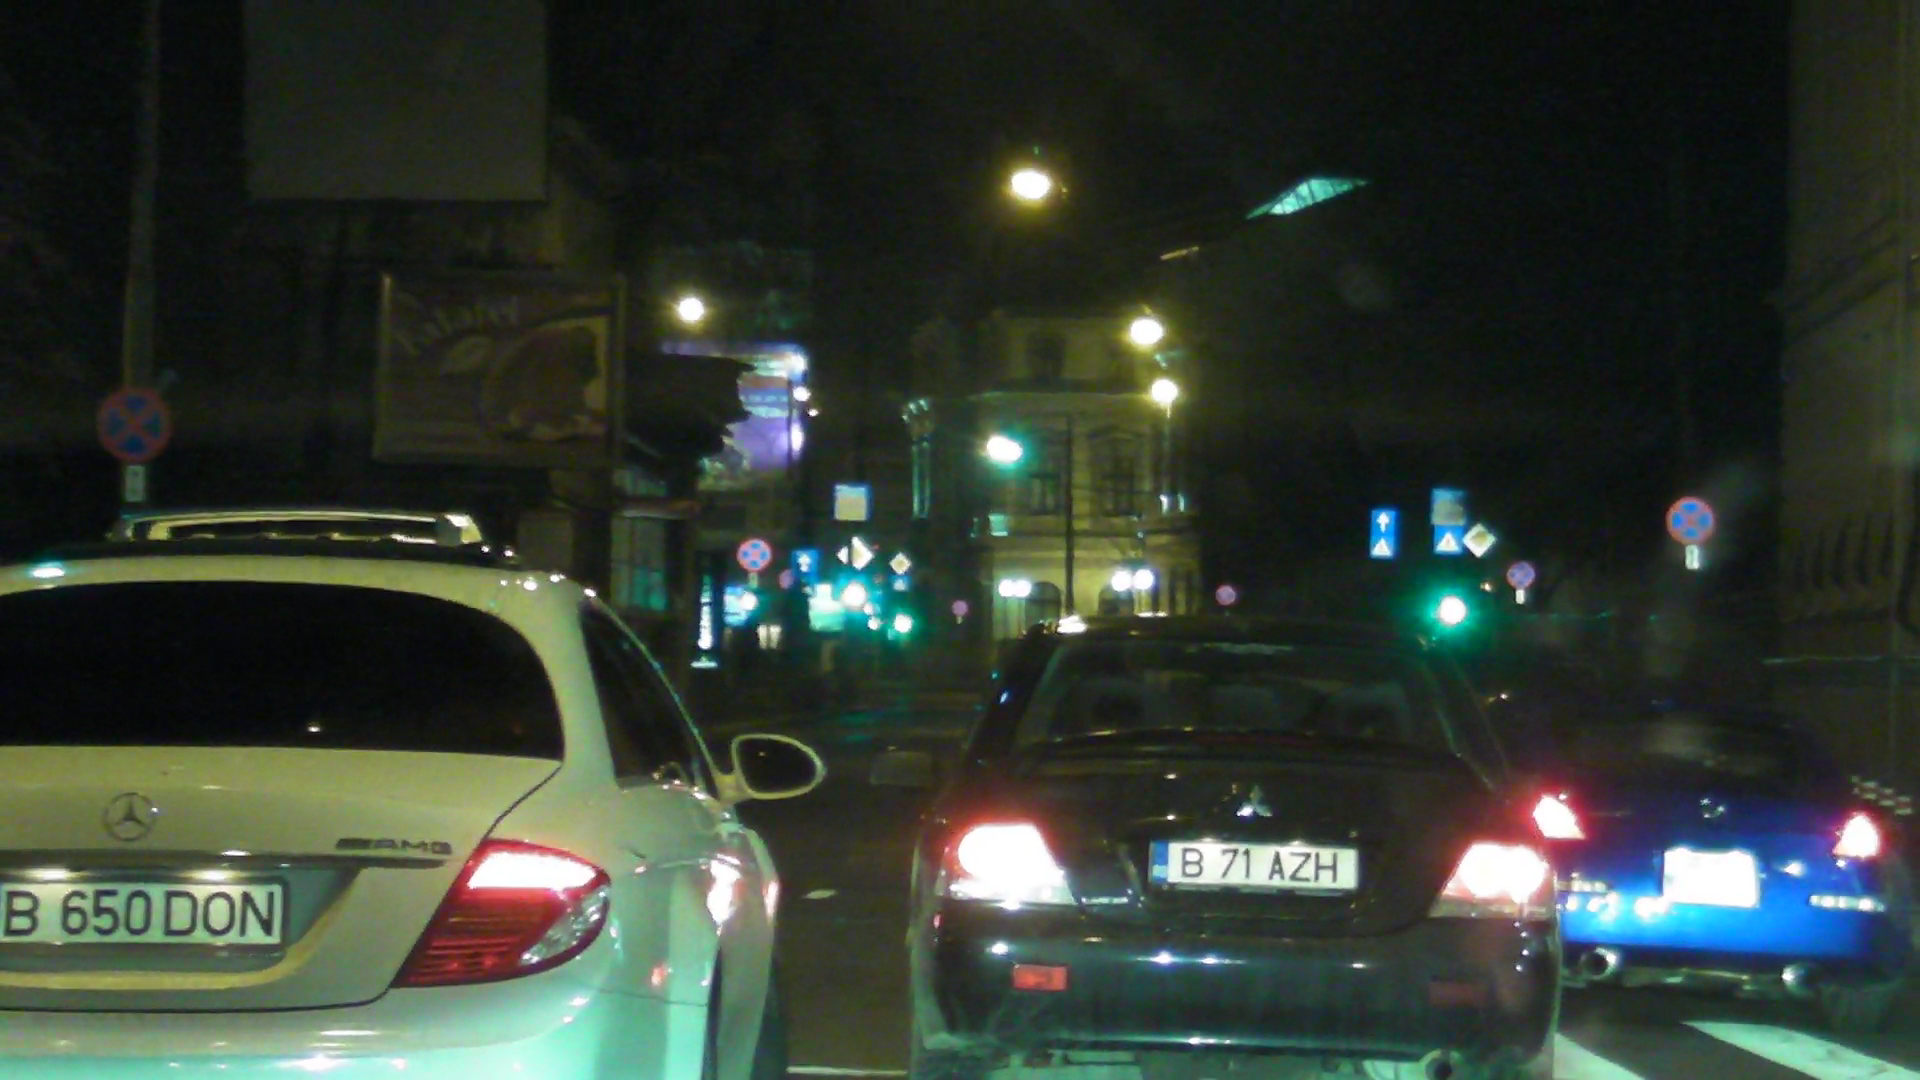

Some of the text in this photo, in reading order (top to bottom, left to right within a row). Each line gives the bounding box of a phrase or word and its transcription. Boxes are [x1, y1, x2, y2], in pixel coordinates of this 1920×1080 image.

[1181, 847, 1338, 883] B 71 AZH
[4, 888, 275, 937] B 650 DON
